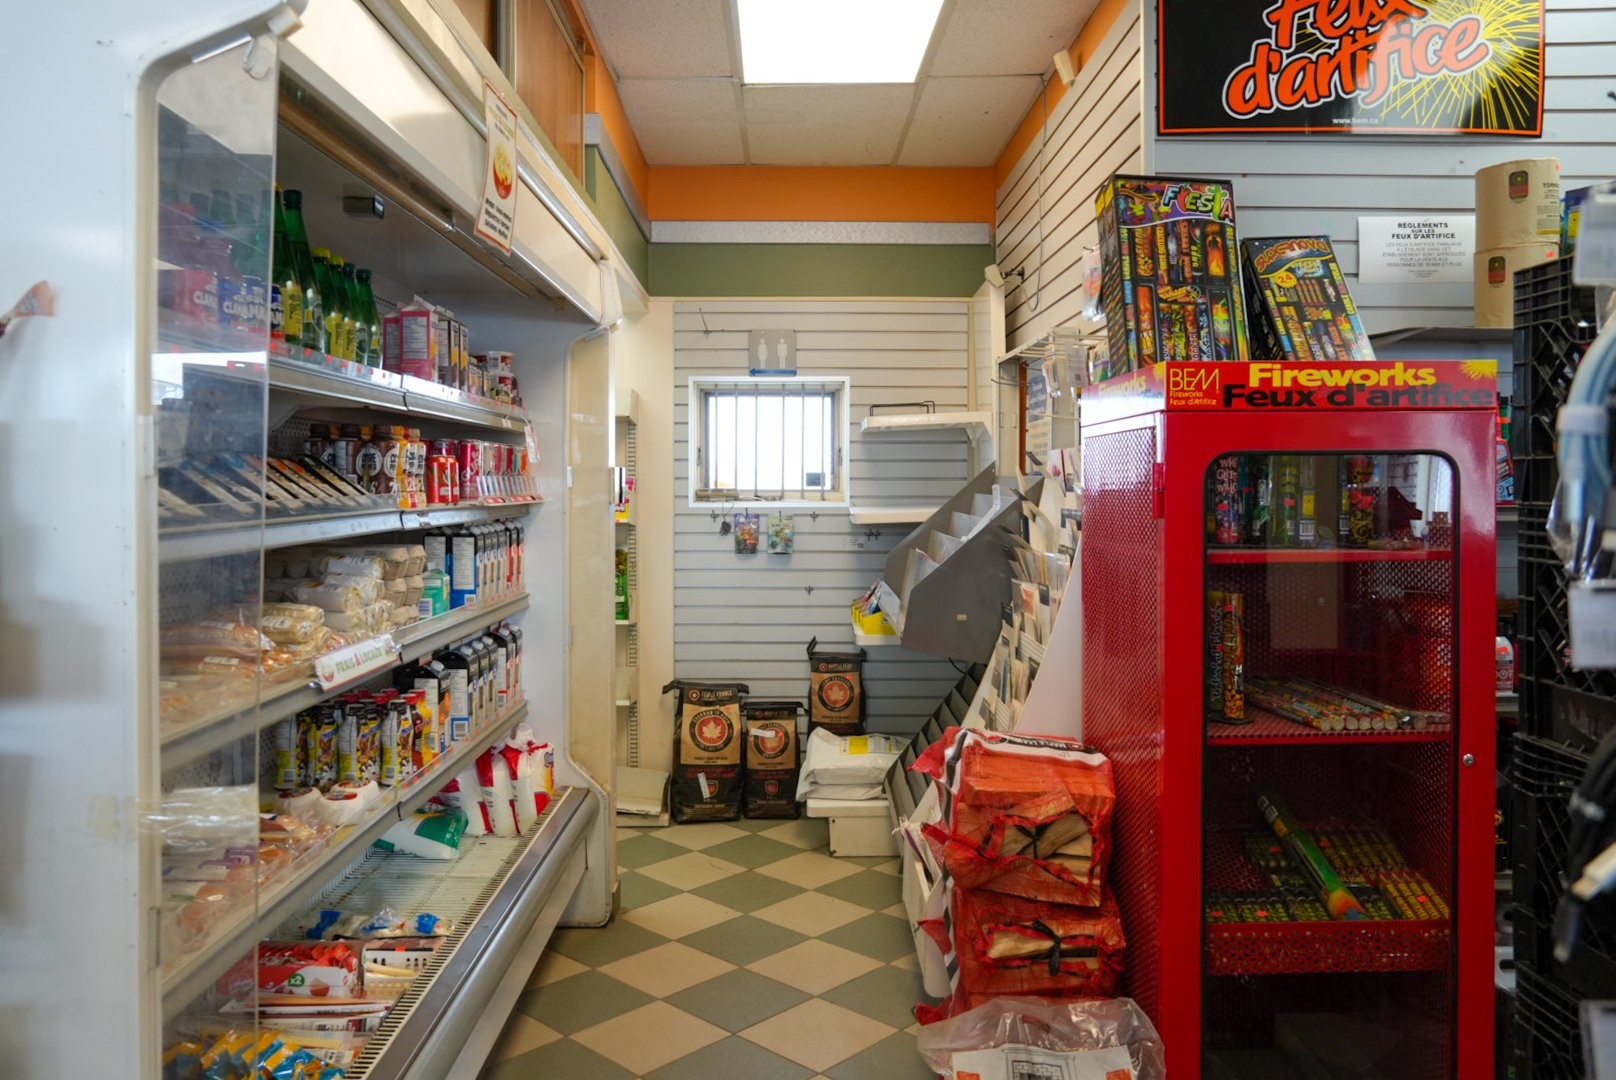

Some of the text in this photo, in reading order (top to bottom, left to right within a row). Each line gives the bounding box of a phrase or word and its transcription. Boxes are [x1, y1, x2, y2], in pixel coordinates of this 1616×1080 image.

[1226, 17, 1490, 115] d'artifice
[1331, 117, 1379, 125] www.bem.ca
[1161, 183, 1234, 222] FIESTA
[1413, 232, 1456, 240] D'ARTIFICE
[1254, 238, 1331, 273] SUPERNOVA
[1169, 368, 1220, 391] BEM
[1249, 362, 1437, 388] Fireworks
[1169, 398, 1186, 406] Feux
[1222, 383, 1495, 407] Feux d'artifice
[335, 658, 355, 673] FRAIS
[1039, 740, 1067, 749] MAPLE
[289, 975, 303, 986] x2
